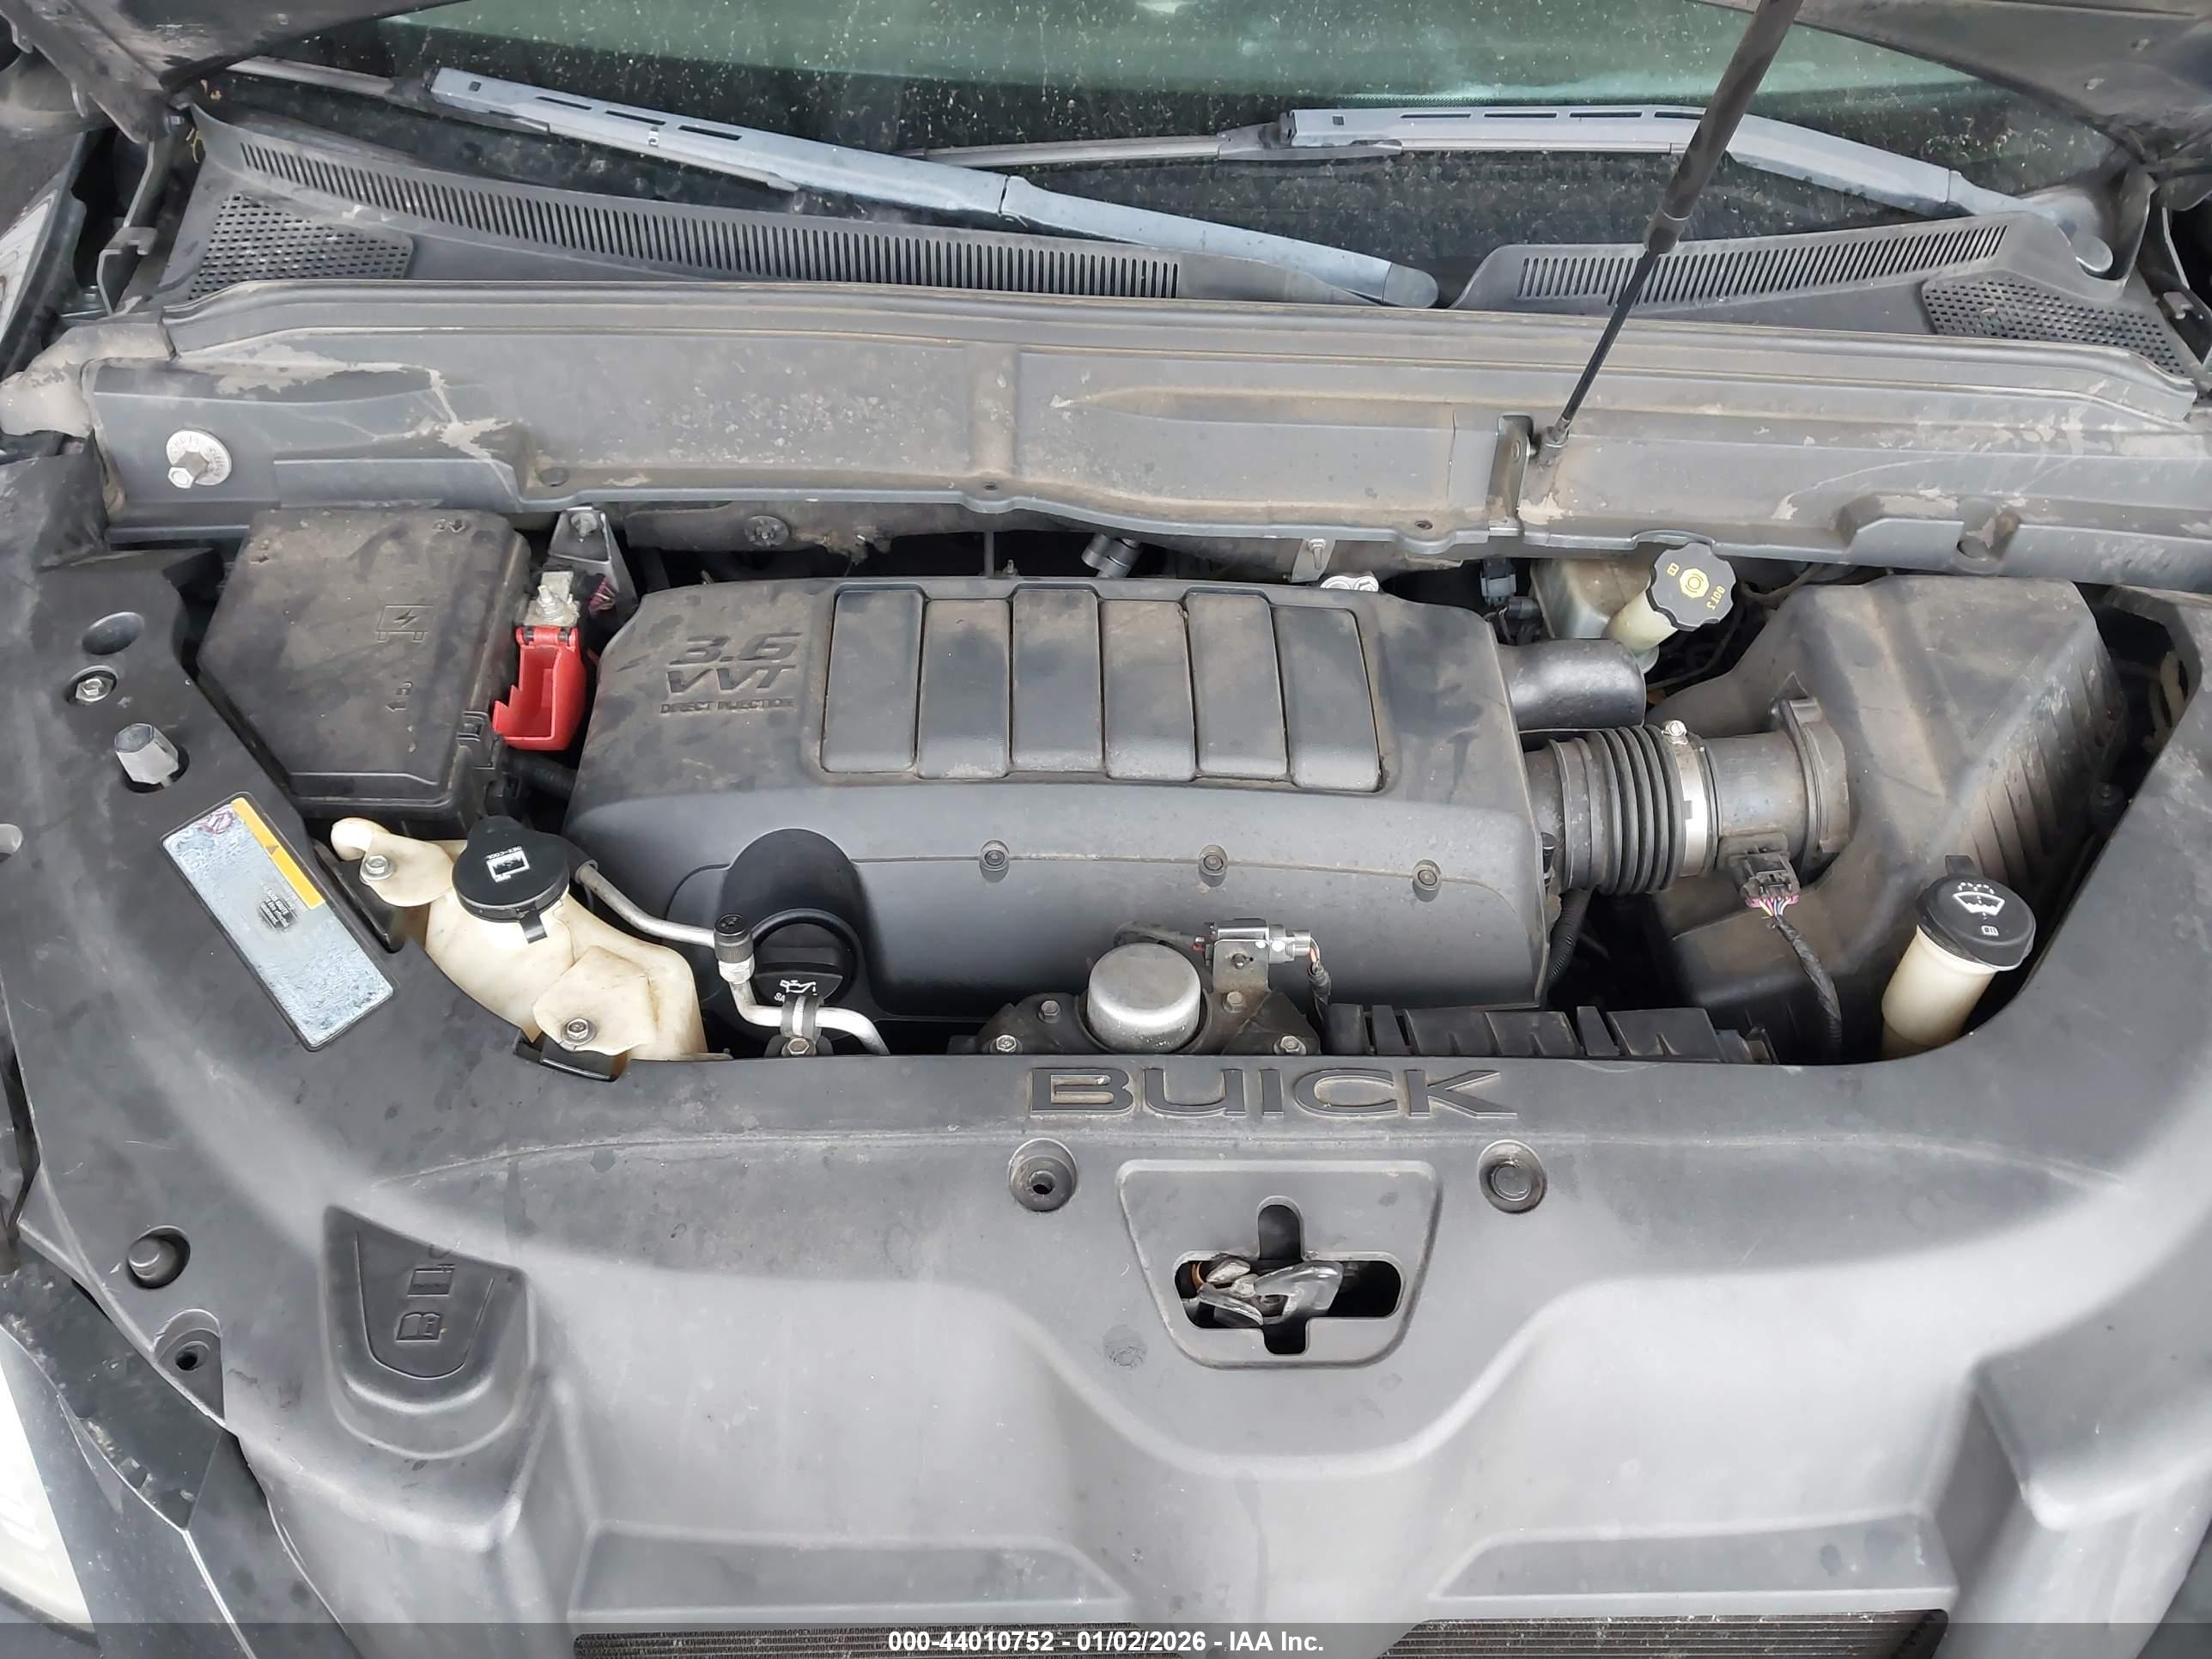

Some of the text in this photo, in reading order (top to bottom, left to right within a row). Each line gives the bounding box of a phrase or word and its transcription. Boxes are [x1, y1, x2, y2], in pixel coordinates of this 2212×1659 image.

[668, 631, 803, 665] 3.6
[667, 665, 797, 694] VVT
[659, 701, 715, 714] DIRECT
[775, 993, 786, 1003] SA
[1031, 1066, 1518, 1119] BUICK
